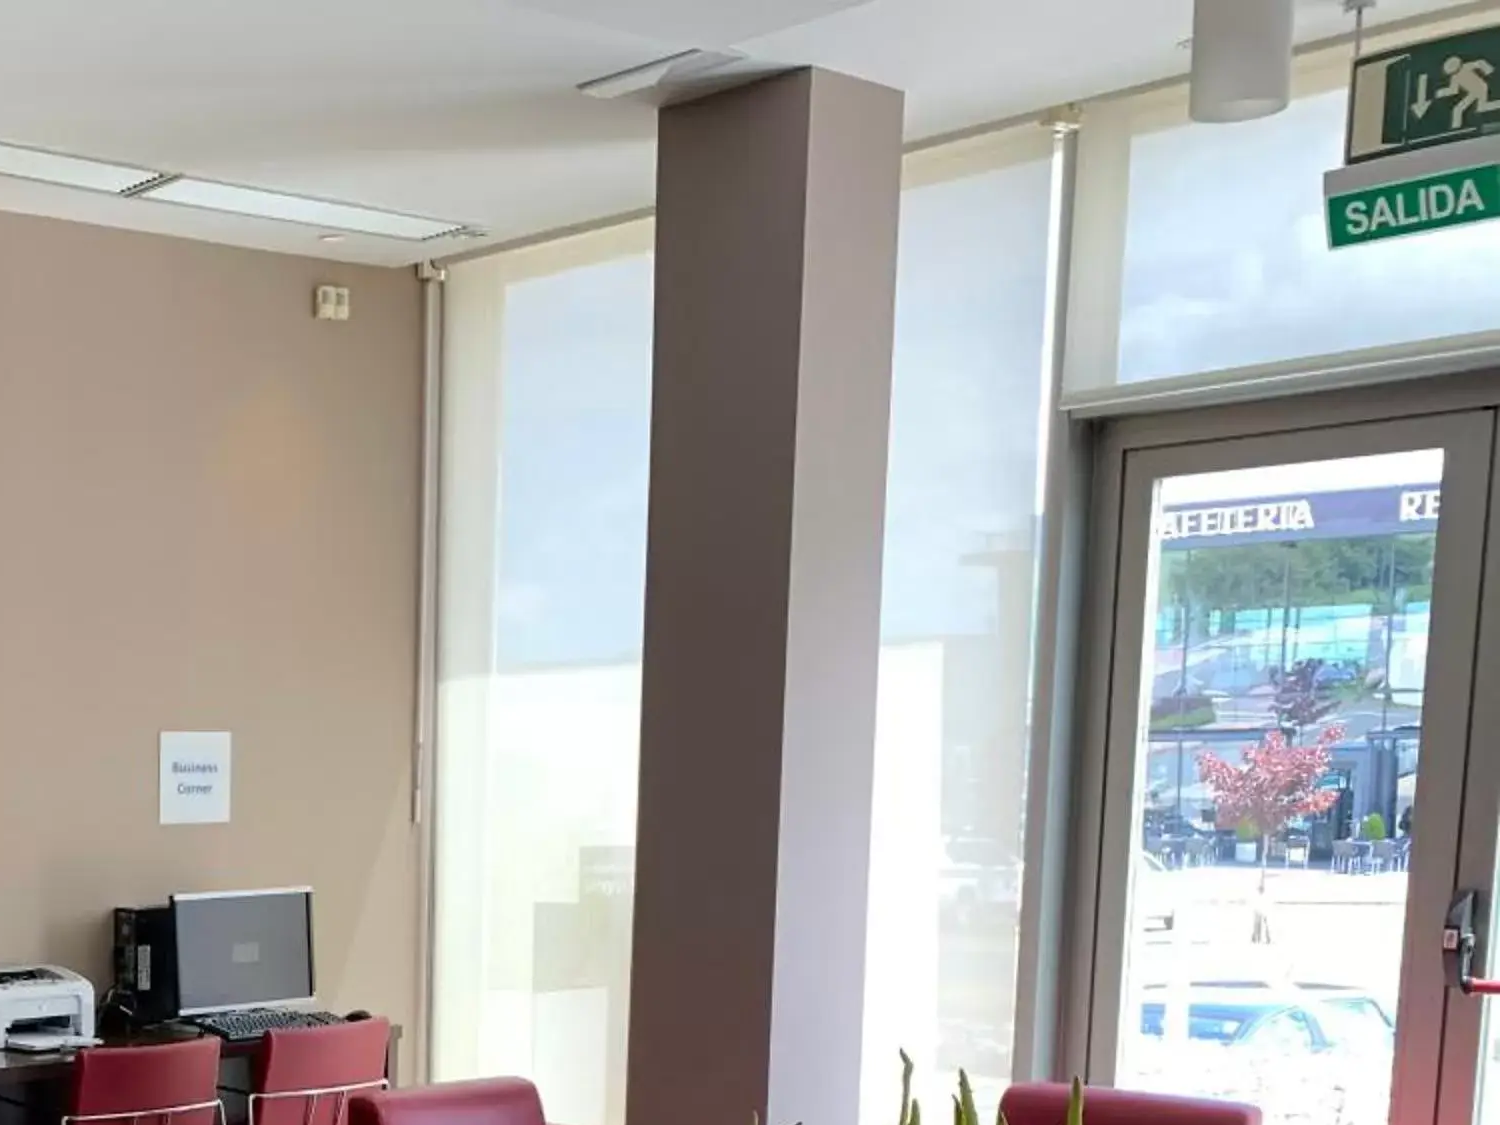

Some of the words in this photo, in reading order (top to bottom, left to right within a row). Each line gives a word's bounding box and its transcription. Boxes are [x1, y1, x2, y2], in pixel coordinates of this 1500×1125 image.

[1345, 179, 1485, 235] SALIDA
[1156, 500, 1315, 539] AFETERIA
[171, 761, 218, 773] Business
[177, 783, 213, 794] Corner
